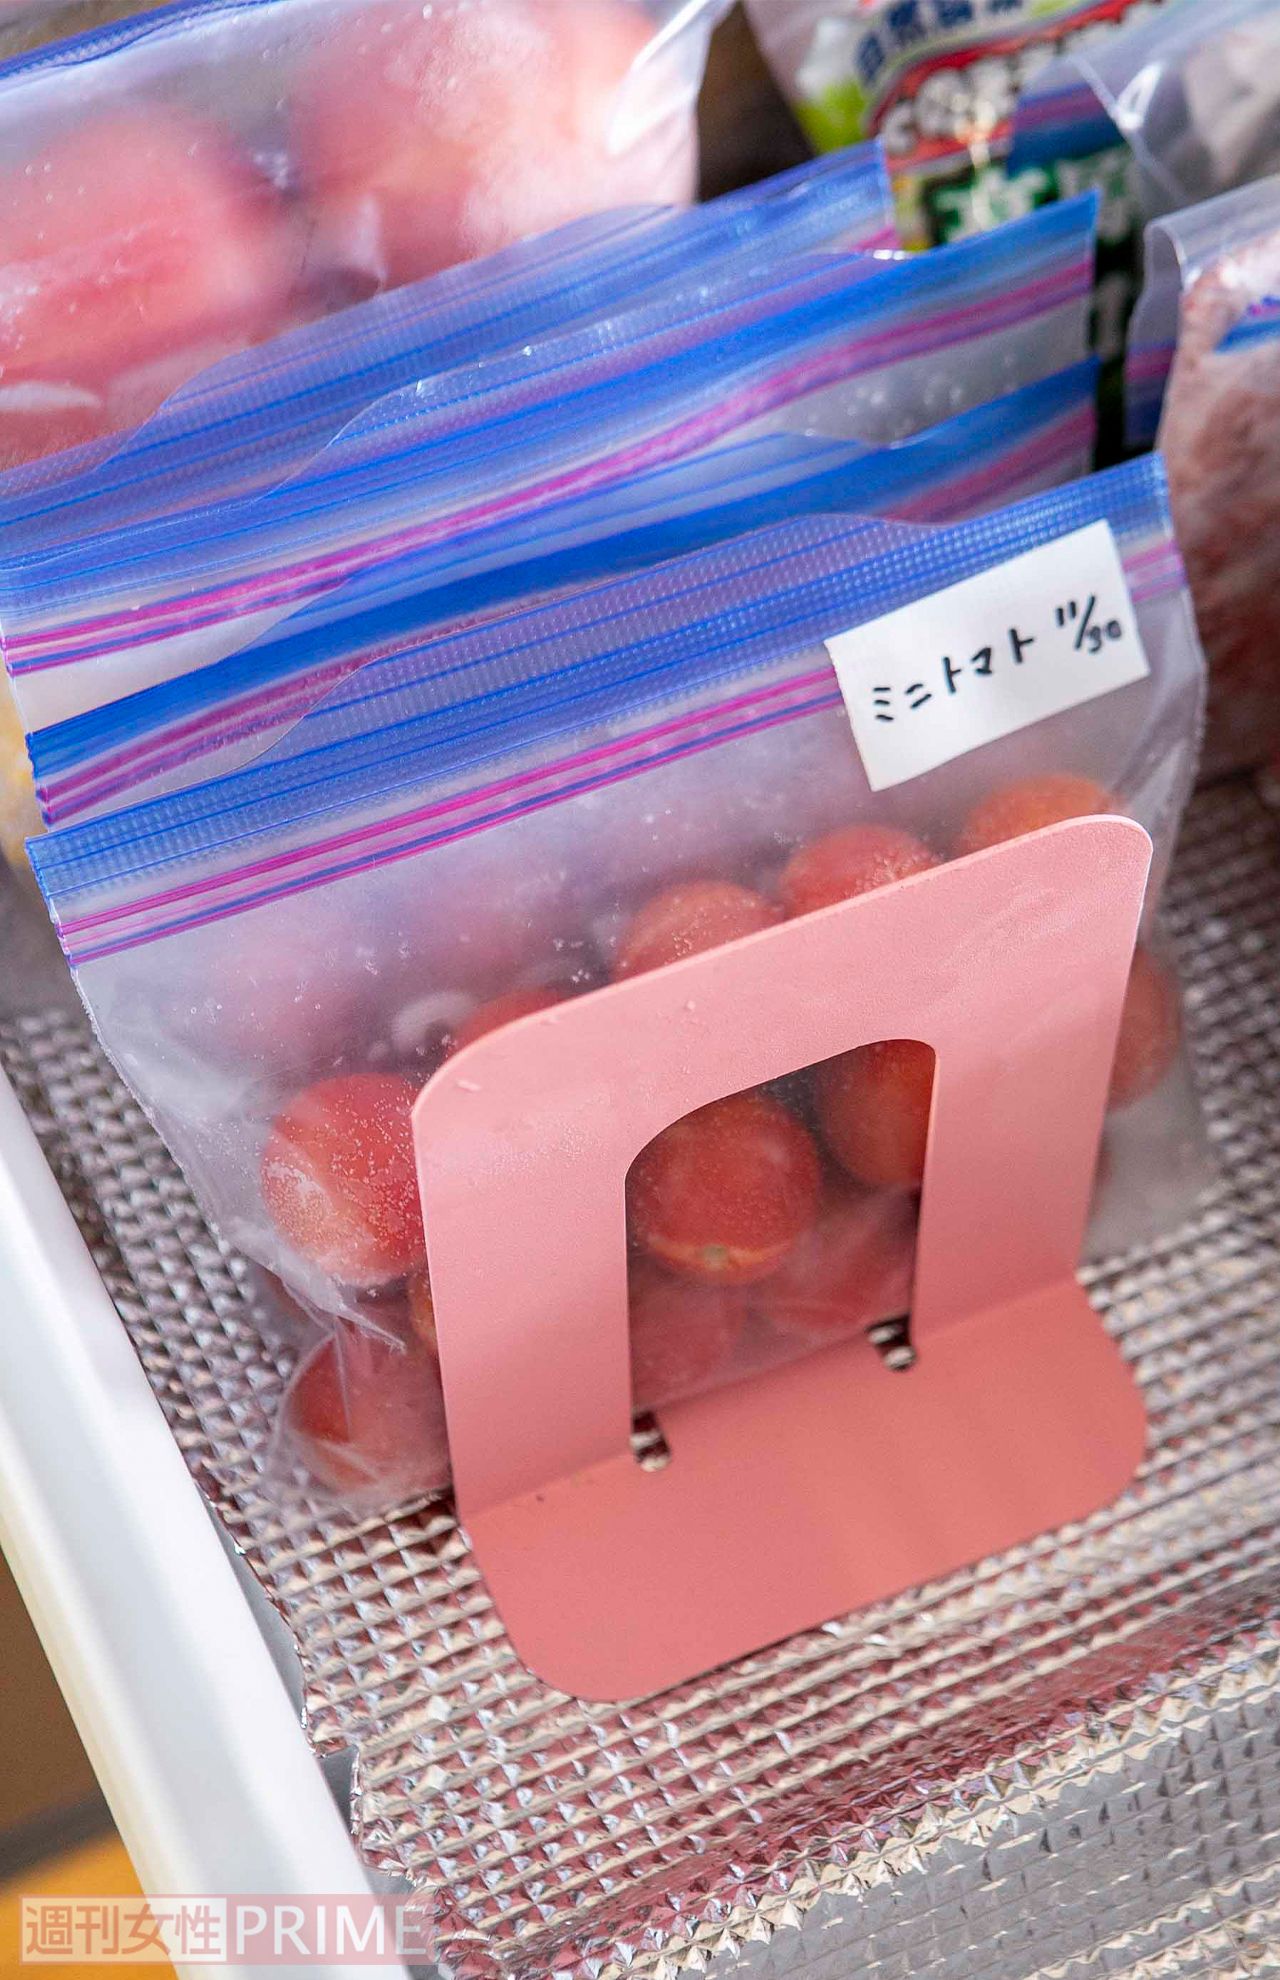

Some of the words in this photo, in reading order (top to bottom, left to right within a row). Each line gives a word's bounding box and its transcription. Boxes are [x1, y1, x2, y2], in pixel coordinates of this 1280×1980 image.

[872, 628, 1034, 721] ミニトマト
[1055, 595, 1122, 654] 11/30
